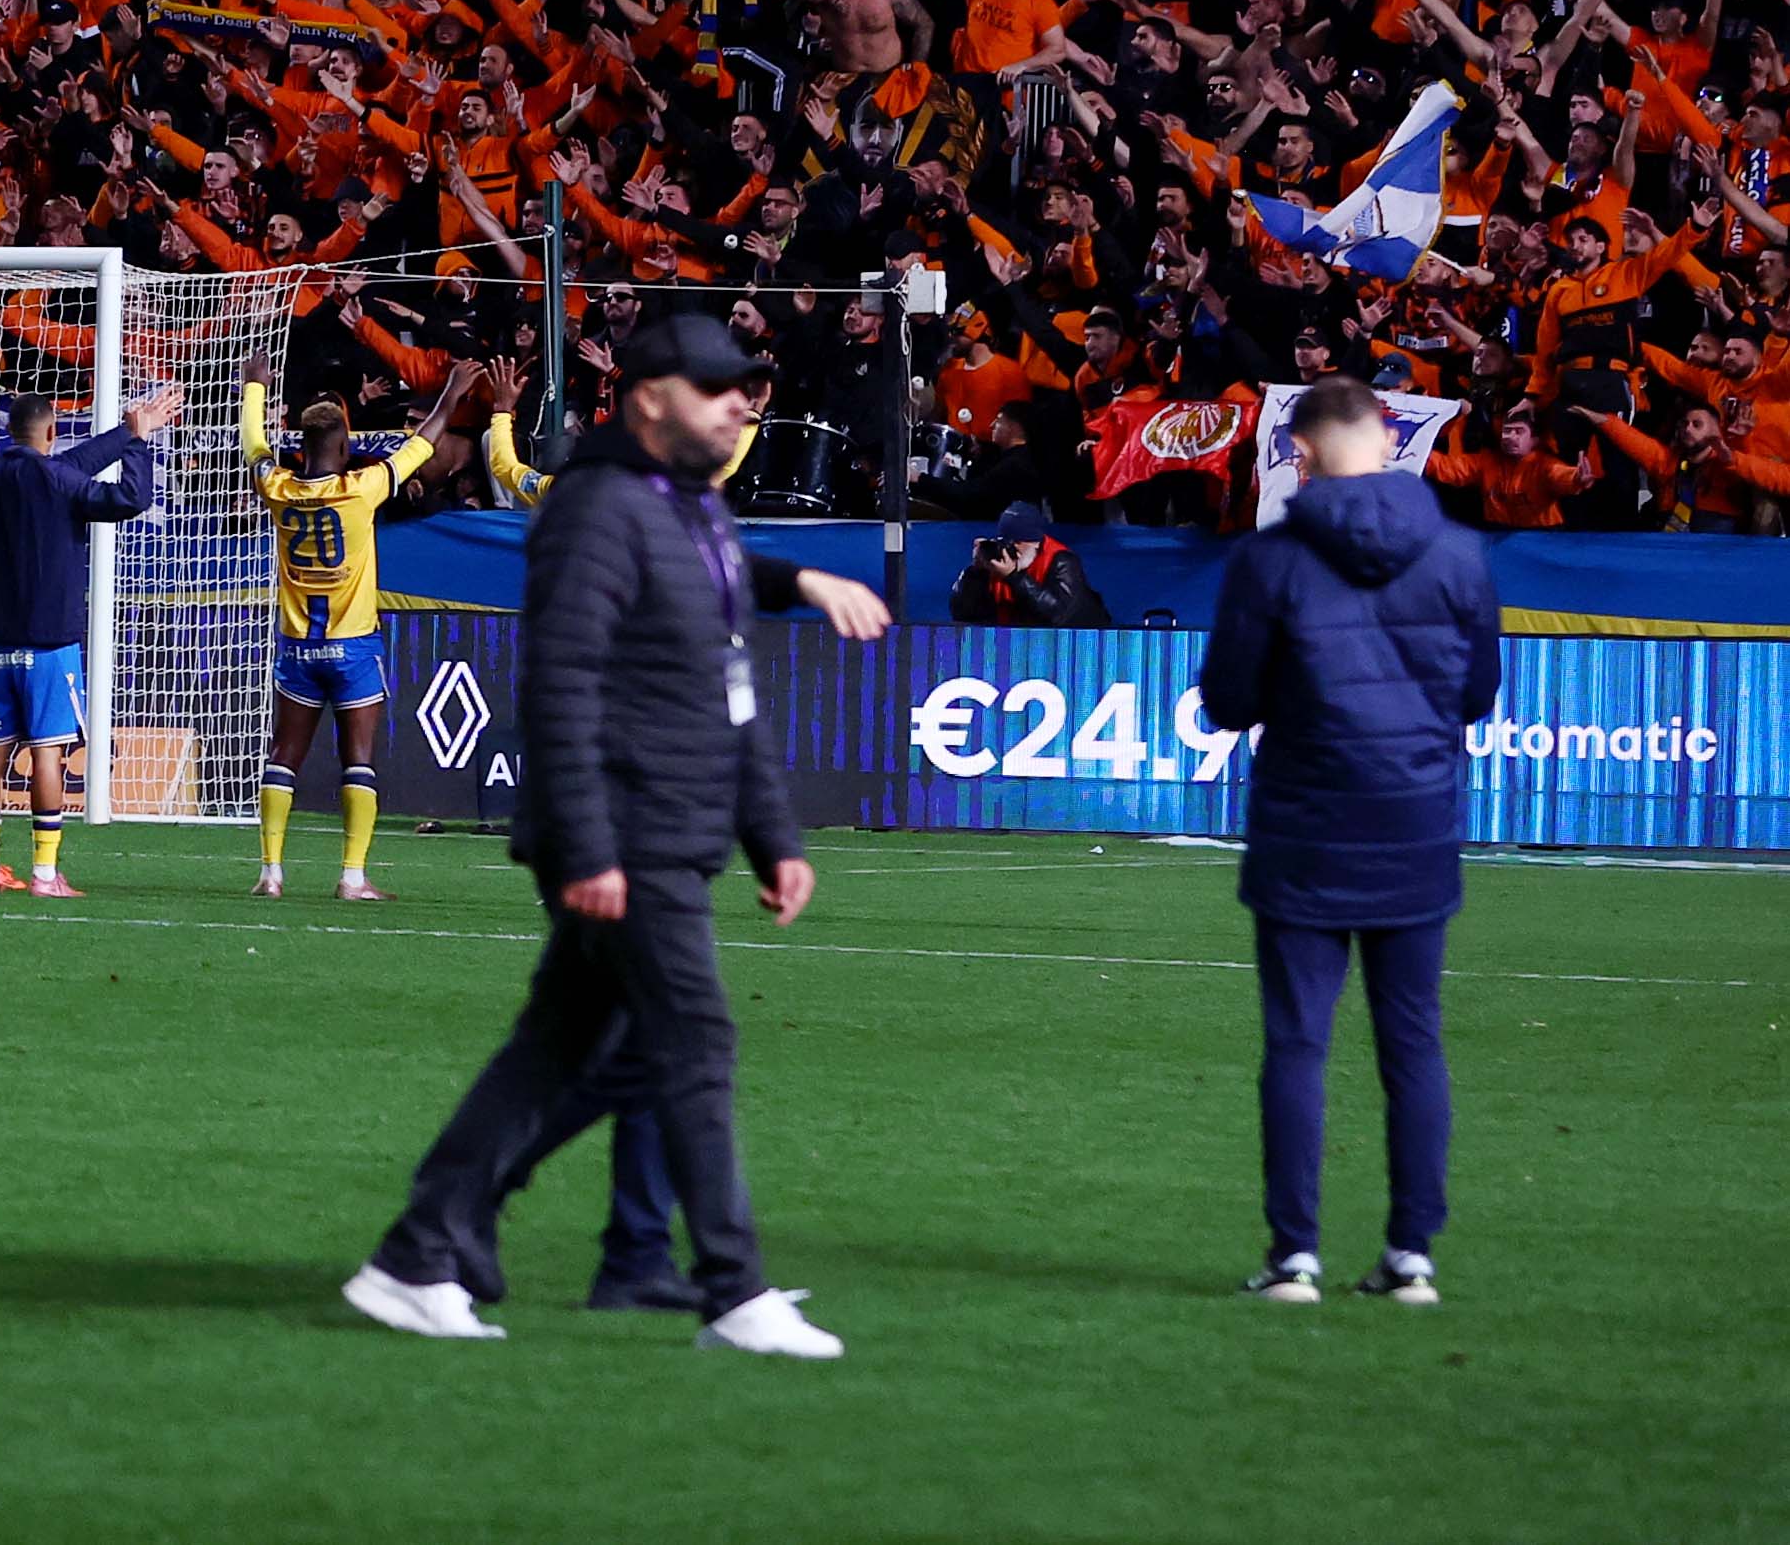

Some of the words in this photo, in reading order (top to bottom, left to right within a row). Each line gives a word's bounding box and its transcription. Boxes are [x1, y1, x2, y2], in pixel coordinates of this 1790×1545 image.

[214, 14, 252, 29] Dead
[291, 25, 321, 37] han
[326, 27, 357, 43] Red
[283, 507, 345, 568] 20
[1465, 716, 1718, 763] utomatic
